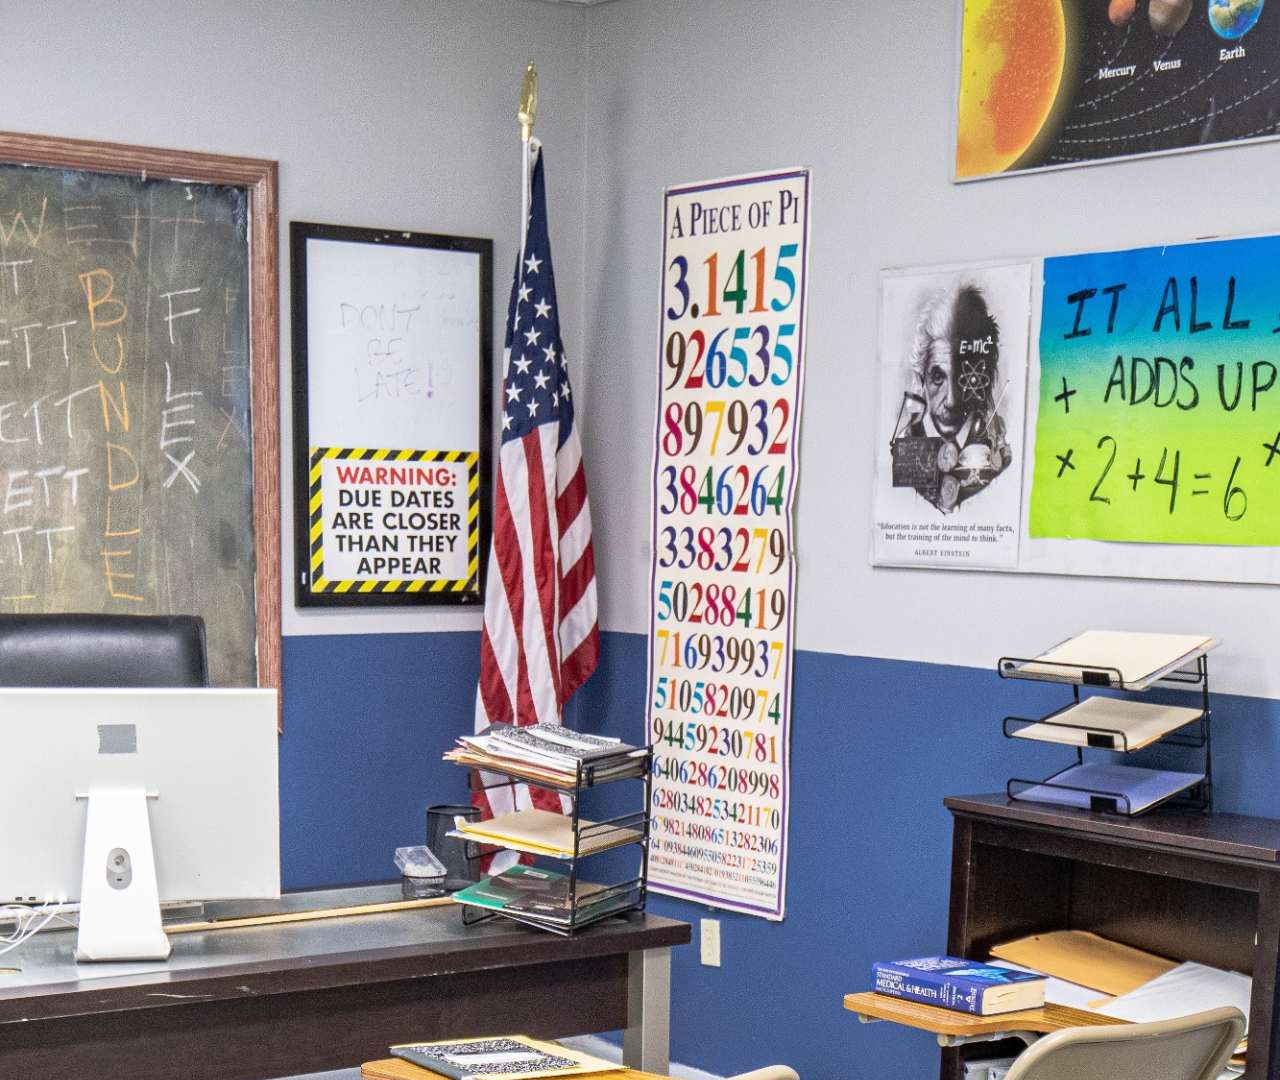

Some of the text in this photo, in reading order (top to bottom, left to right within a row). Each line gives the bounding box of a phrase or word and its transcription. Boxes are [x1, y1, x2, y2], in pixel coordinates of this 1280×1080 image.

[1098, 63, 1136, 80] Mercury
[1152, 57, 1182, 73] Venus
[1219, 47, 1245, 61] Earth
[671, 205, 684, 239] A
[667, 243, 799, 320] 3.1415
[1063, 275, 1250, 339] IT ALL
[665, 323, 796, 391] 926535
[1103, 355, 1278, 412] ADDS UP
[663, 398, 790, 456] 897932
[336, 466, 457, 487] WARNING:
[660, 464, 785, 516] 3846264
[338, 489, 454, 508] DUE DATES
[332, 512, 461, 531] ARE CLOSER
[907, 533, 932, 542] training
[933, 533, 941, 541] of
[930, 523, 940, 531] the
[941, 524, 968, 532] learning
[977, 525, 994, 533] many
[335, 534, 458, 553] THAN THEY
[660, 525, 785, 575] 3383279
[914, 549, 970, 557] ALBERT EINSTEIN
[357, 556, 441, 575] APPEAR
[657, 580, 785, 632] 50288419
[657, 629, 784, 680] 716939937
[654, 677, 781, 725] 5105820974
[654, 717, 776, 763] 94459230781
[652, 755, 779, 799] 6406286208998
